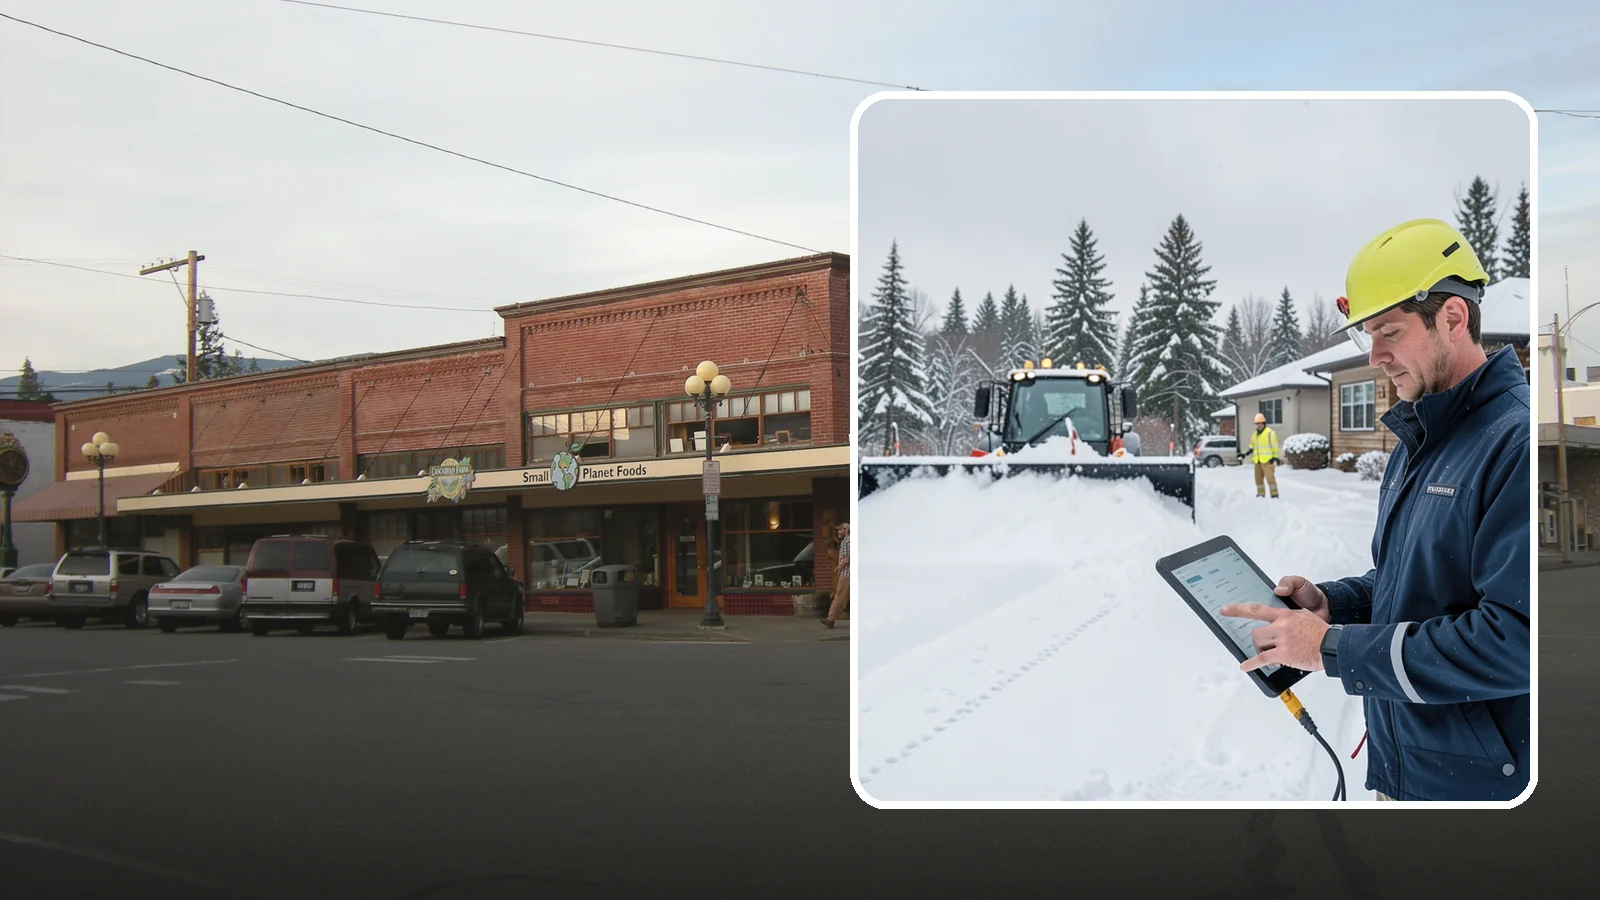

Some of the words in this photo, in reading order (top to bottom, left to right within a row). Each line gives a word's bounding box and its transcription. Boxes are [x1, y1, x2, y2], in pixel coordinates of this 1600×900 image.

[523, 471, 549, 483] Small
[583, 468, 614, 479] Planet
[617, 464, 647, 477] Foods
